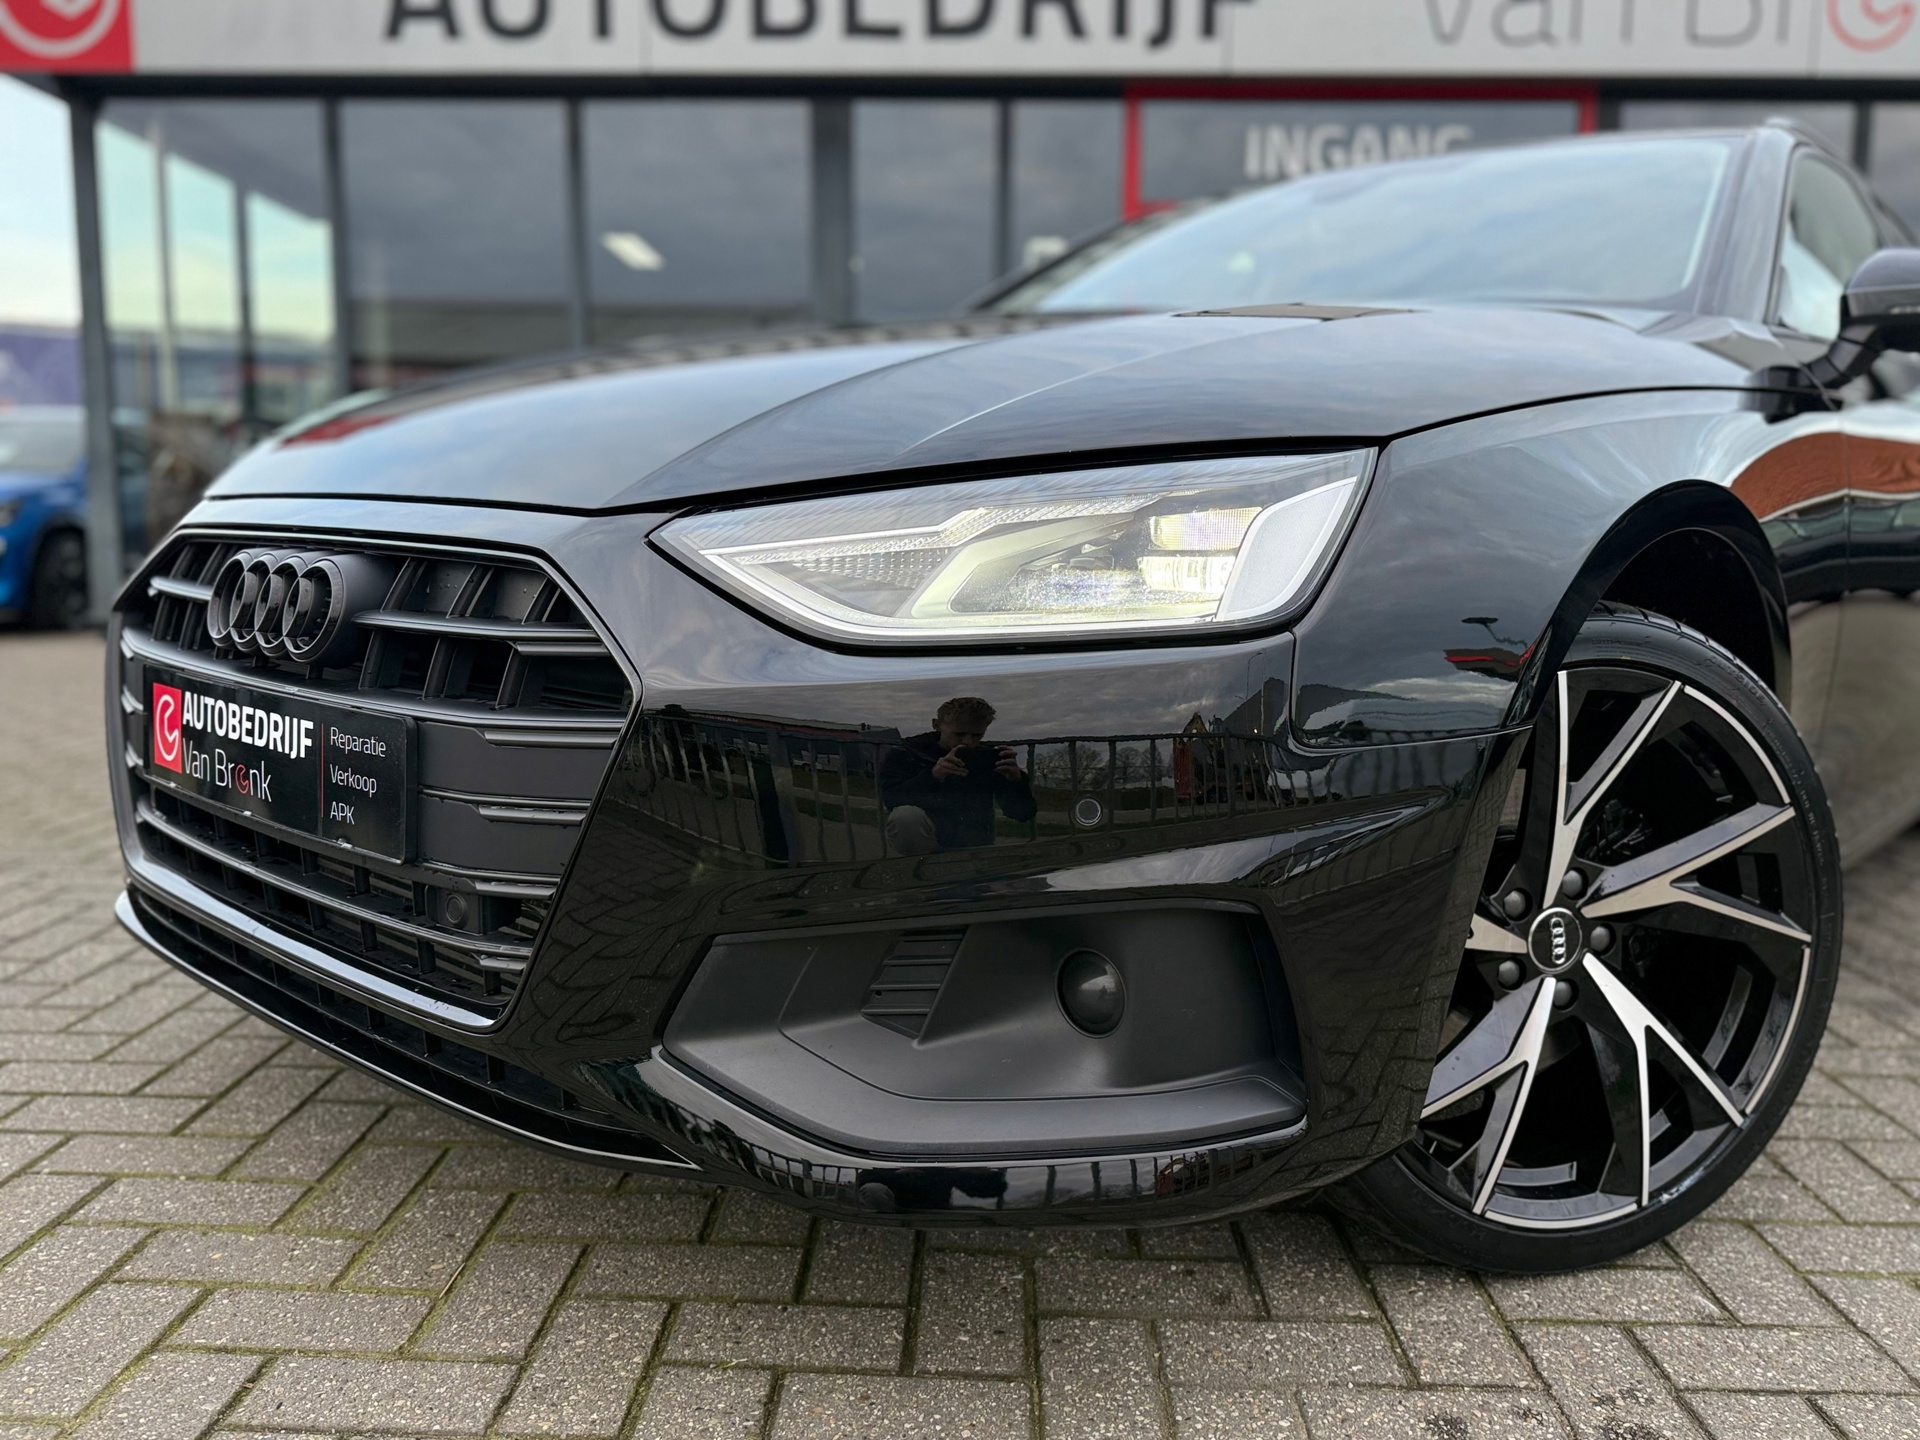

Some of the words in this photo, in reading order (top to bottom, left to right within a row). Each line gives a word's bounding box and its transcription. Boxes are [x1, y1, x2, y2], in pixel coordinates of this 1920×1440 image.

[183, 691, 314, 760] AUTOBEDRIJF
[330, 727, 386, 758] Reparatie
[183, 738, 211, 782] Van
[214, 748, 272, 803] Bronk
[329, 764, 378, 798] Verkoop
[329, 801, 355, 826] APK
